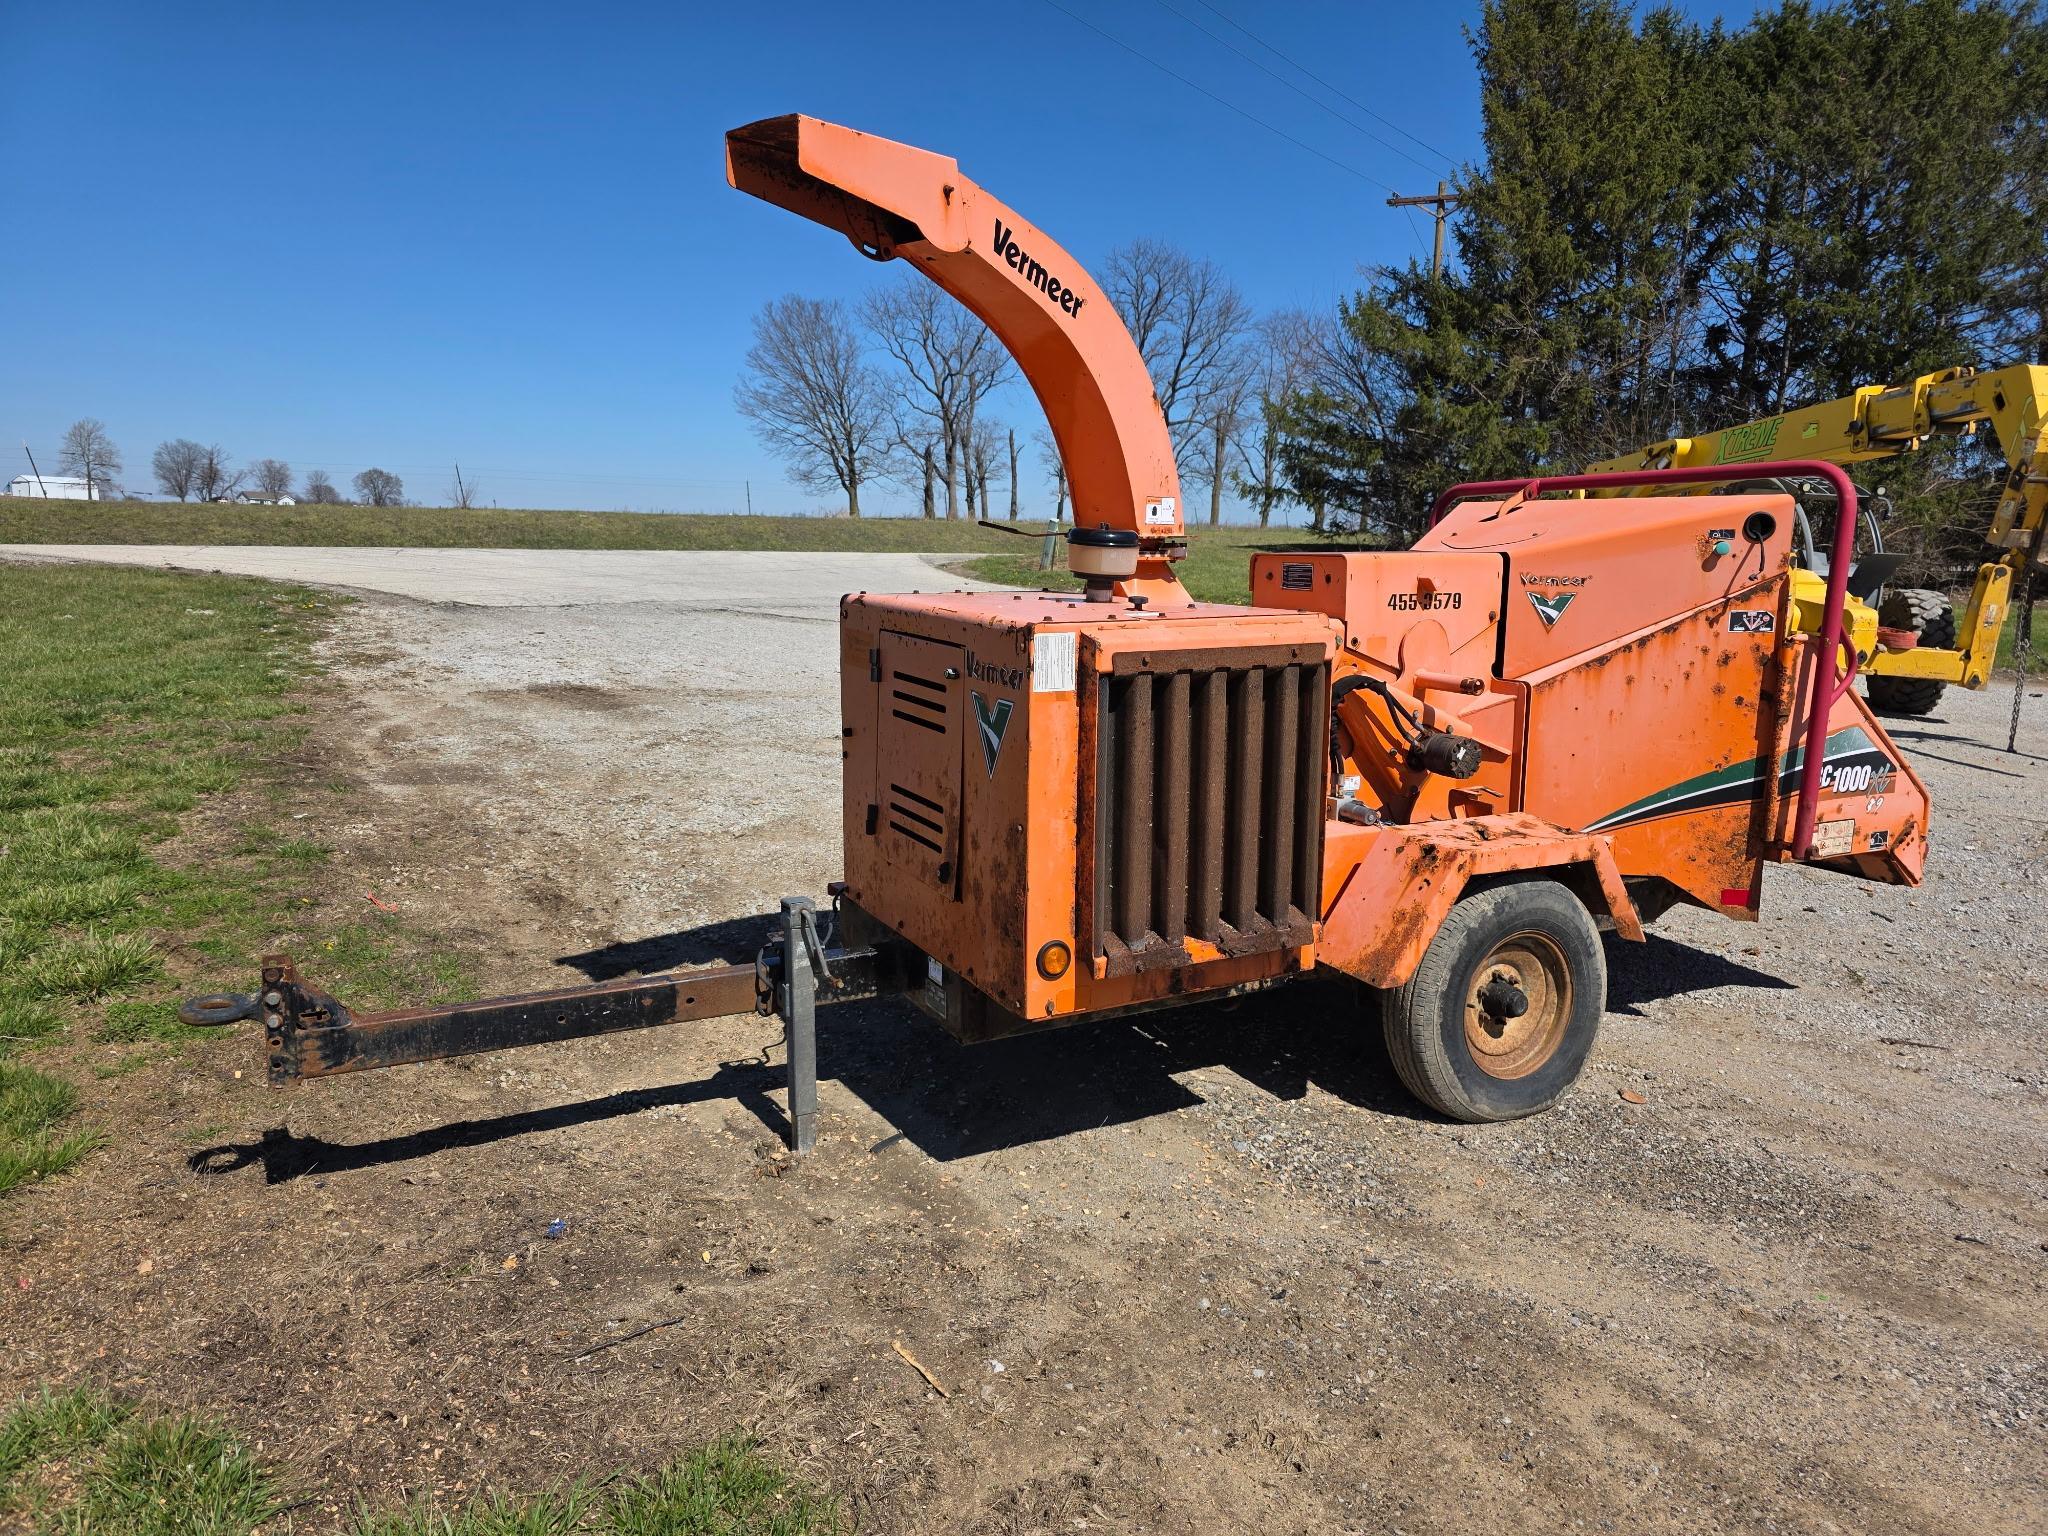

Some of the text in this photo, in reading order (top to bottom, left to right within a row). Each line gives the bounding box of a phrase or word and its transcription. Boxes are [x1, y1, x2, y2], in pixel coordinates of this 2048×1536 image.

[993, 217, 1083, 320] Vermeer
[1712, 417, 1784, 466] XTREME
[1519, 572, 1588, 587] Vermeer
[966, 649, 1024, 690] Vermeer
